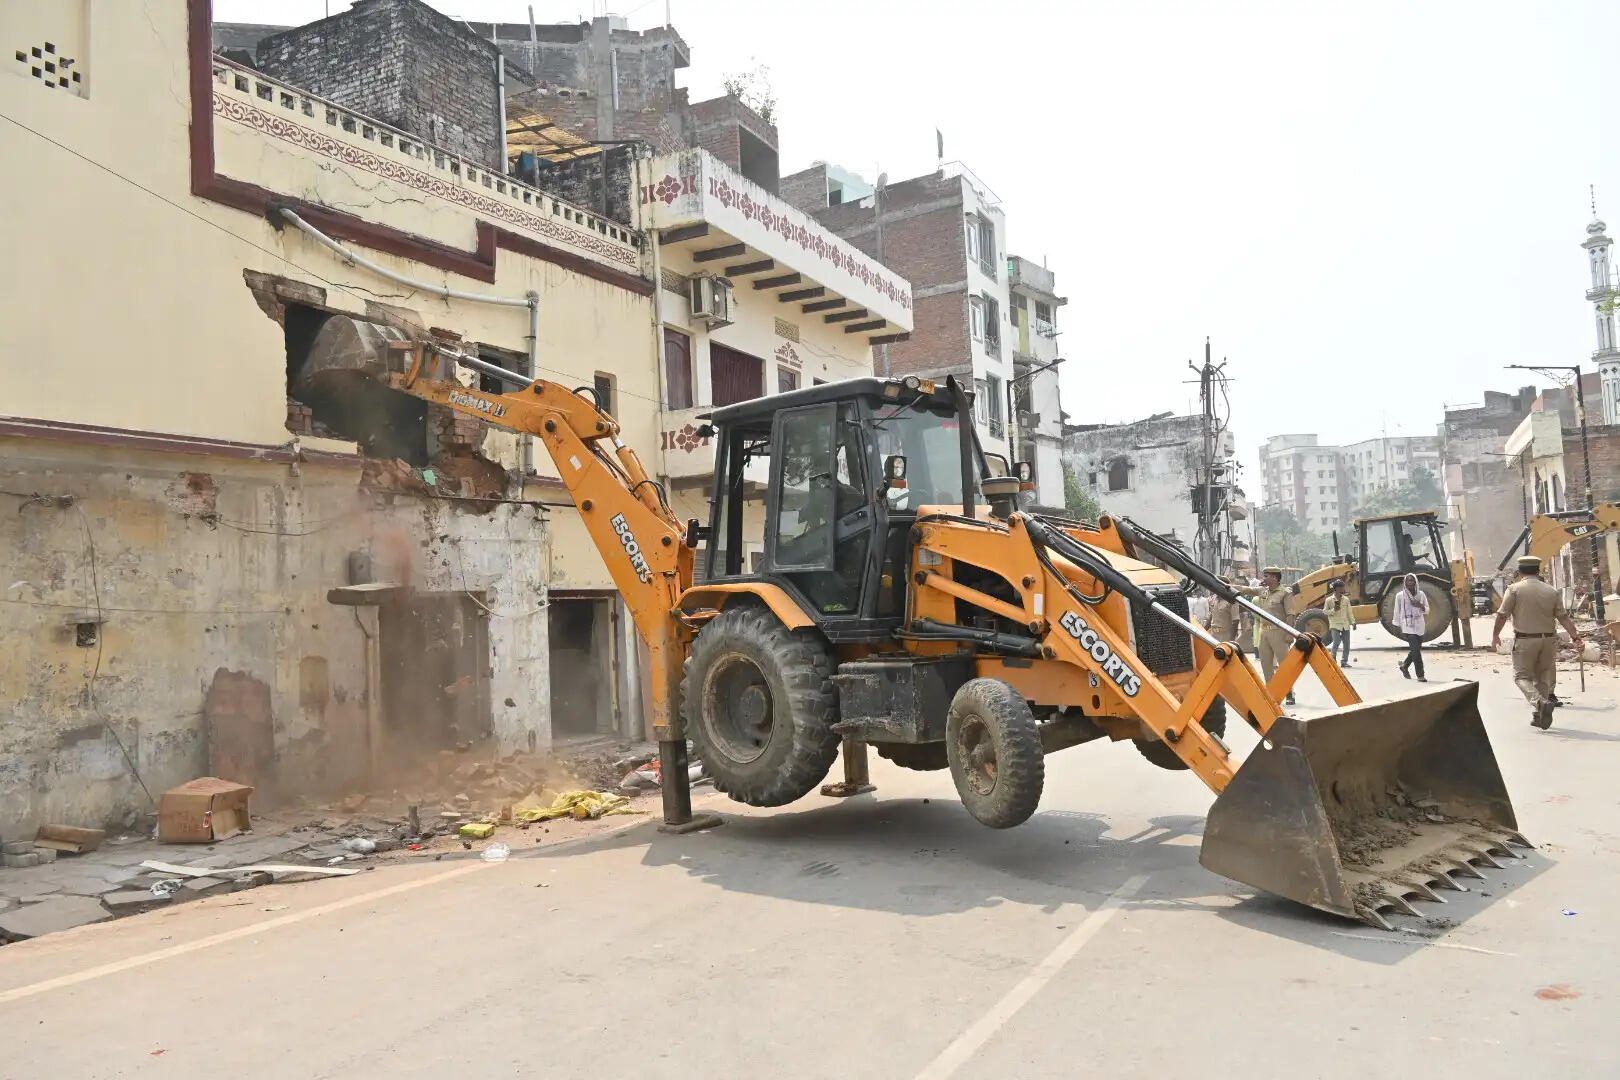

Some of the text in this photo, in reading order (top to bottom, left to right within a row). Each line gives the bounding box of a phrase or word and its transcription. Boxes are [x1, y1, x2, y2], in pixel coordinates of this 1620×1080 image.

[610, 512, 652, 584] ESCORTS
[1573, 525, 1588, 536] CAT
[1058, 610, 1142, 697] ESCORTS
